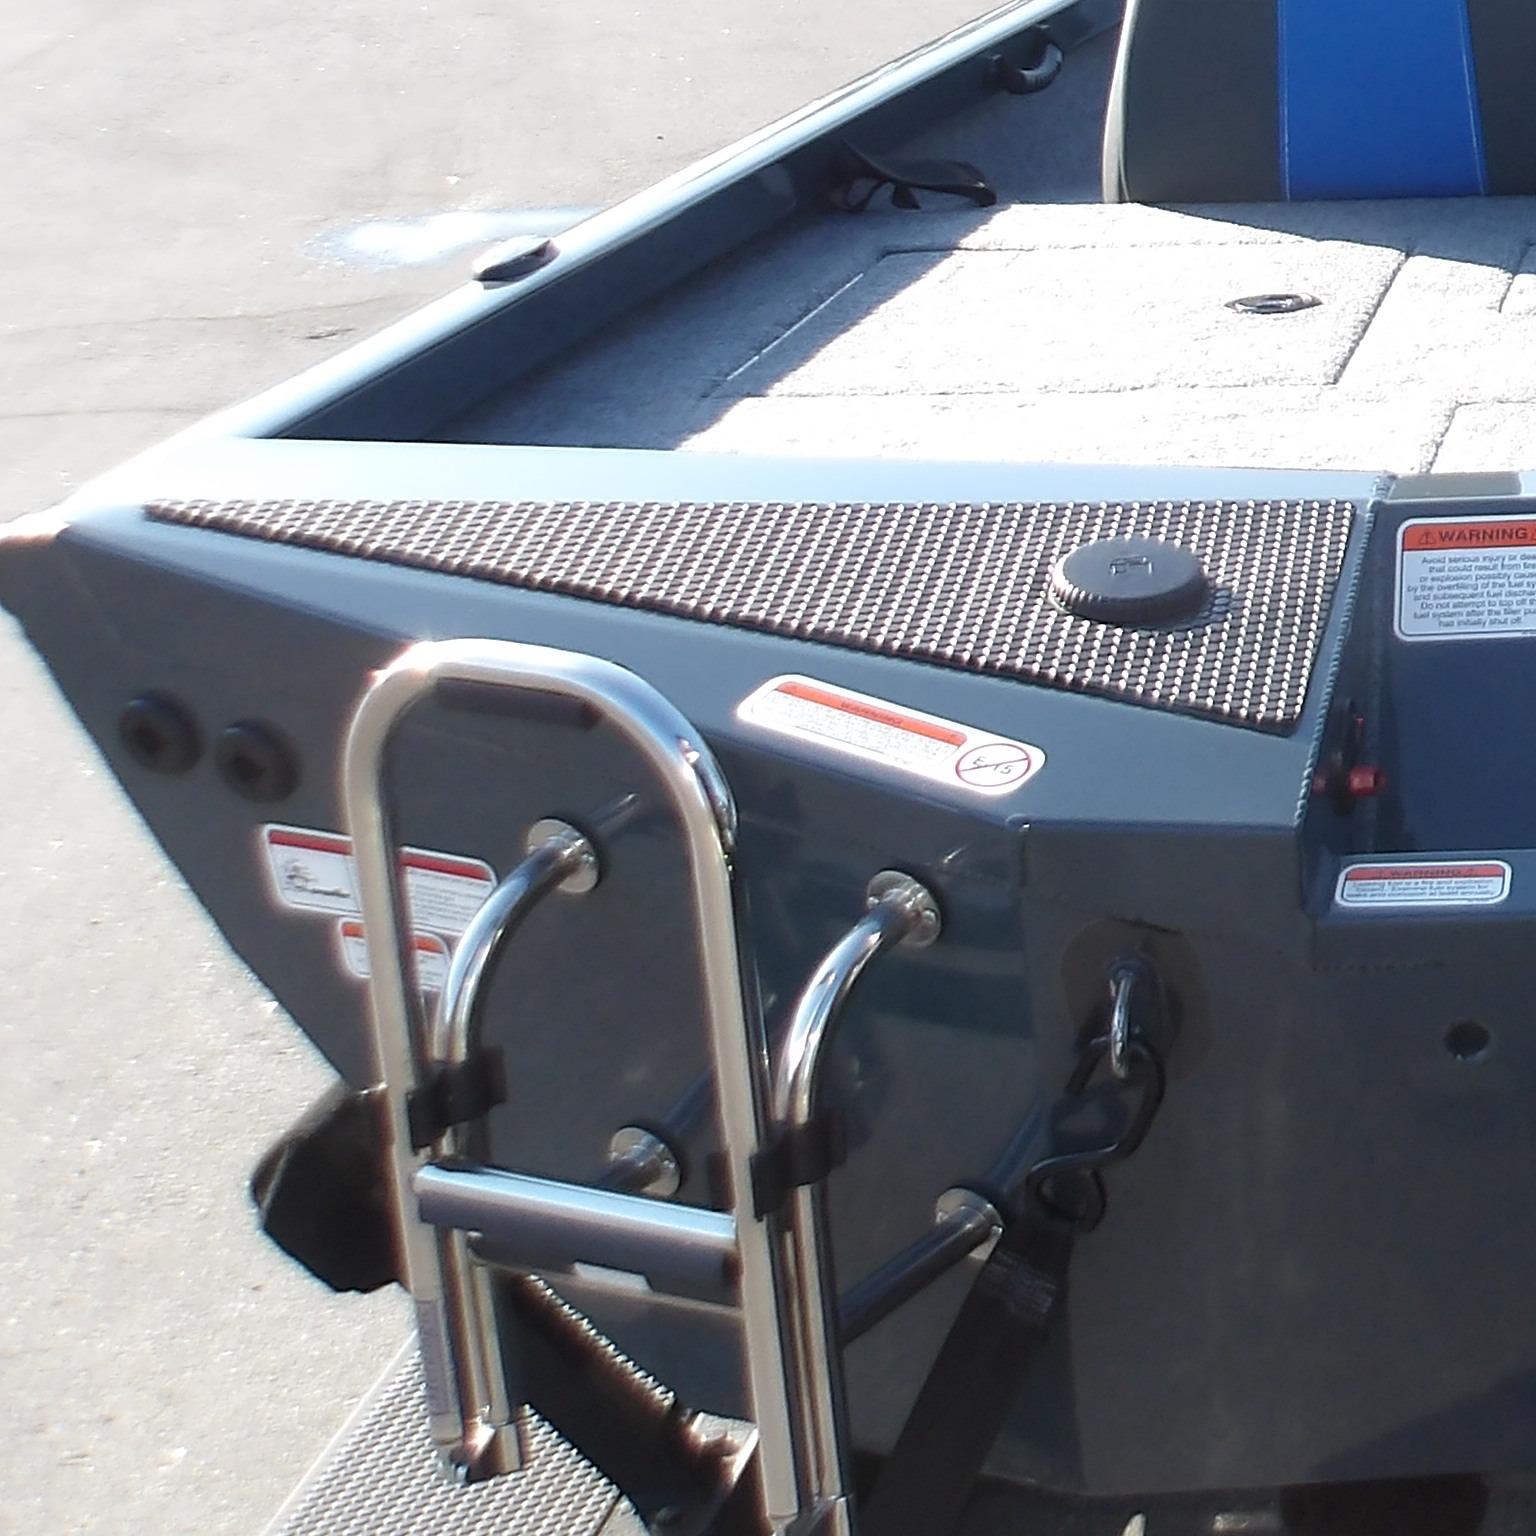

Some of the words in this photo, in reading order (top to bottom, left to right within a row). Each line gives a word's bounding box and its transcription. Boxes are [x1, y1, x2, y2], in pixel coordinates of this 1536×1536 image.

[1438, 527, 1529, 543] WARNING
[1448, 564, 1473, 573] could
[1500, 562, 1521, 571] from
